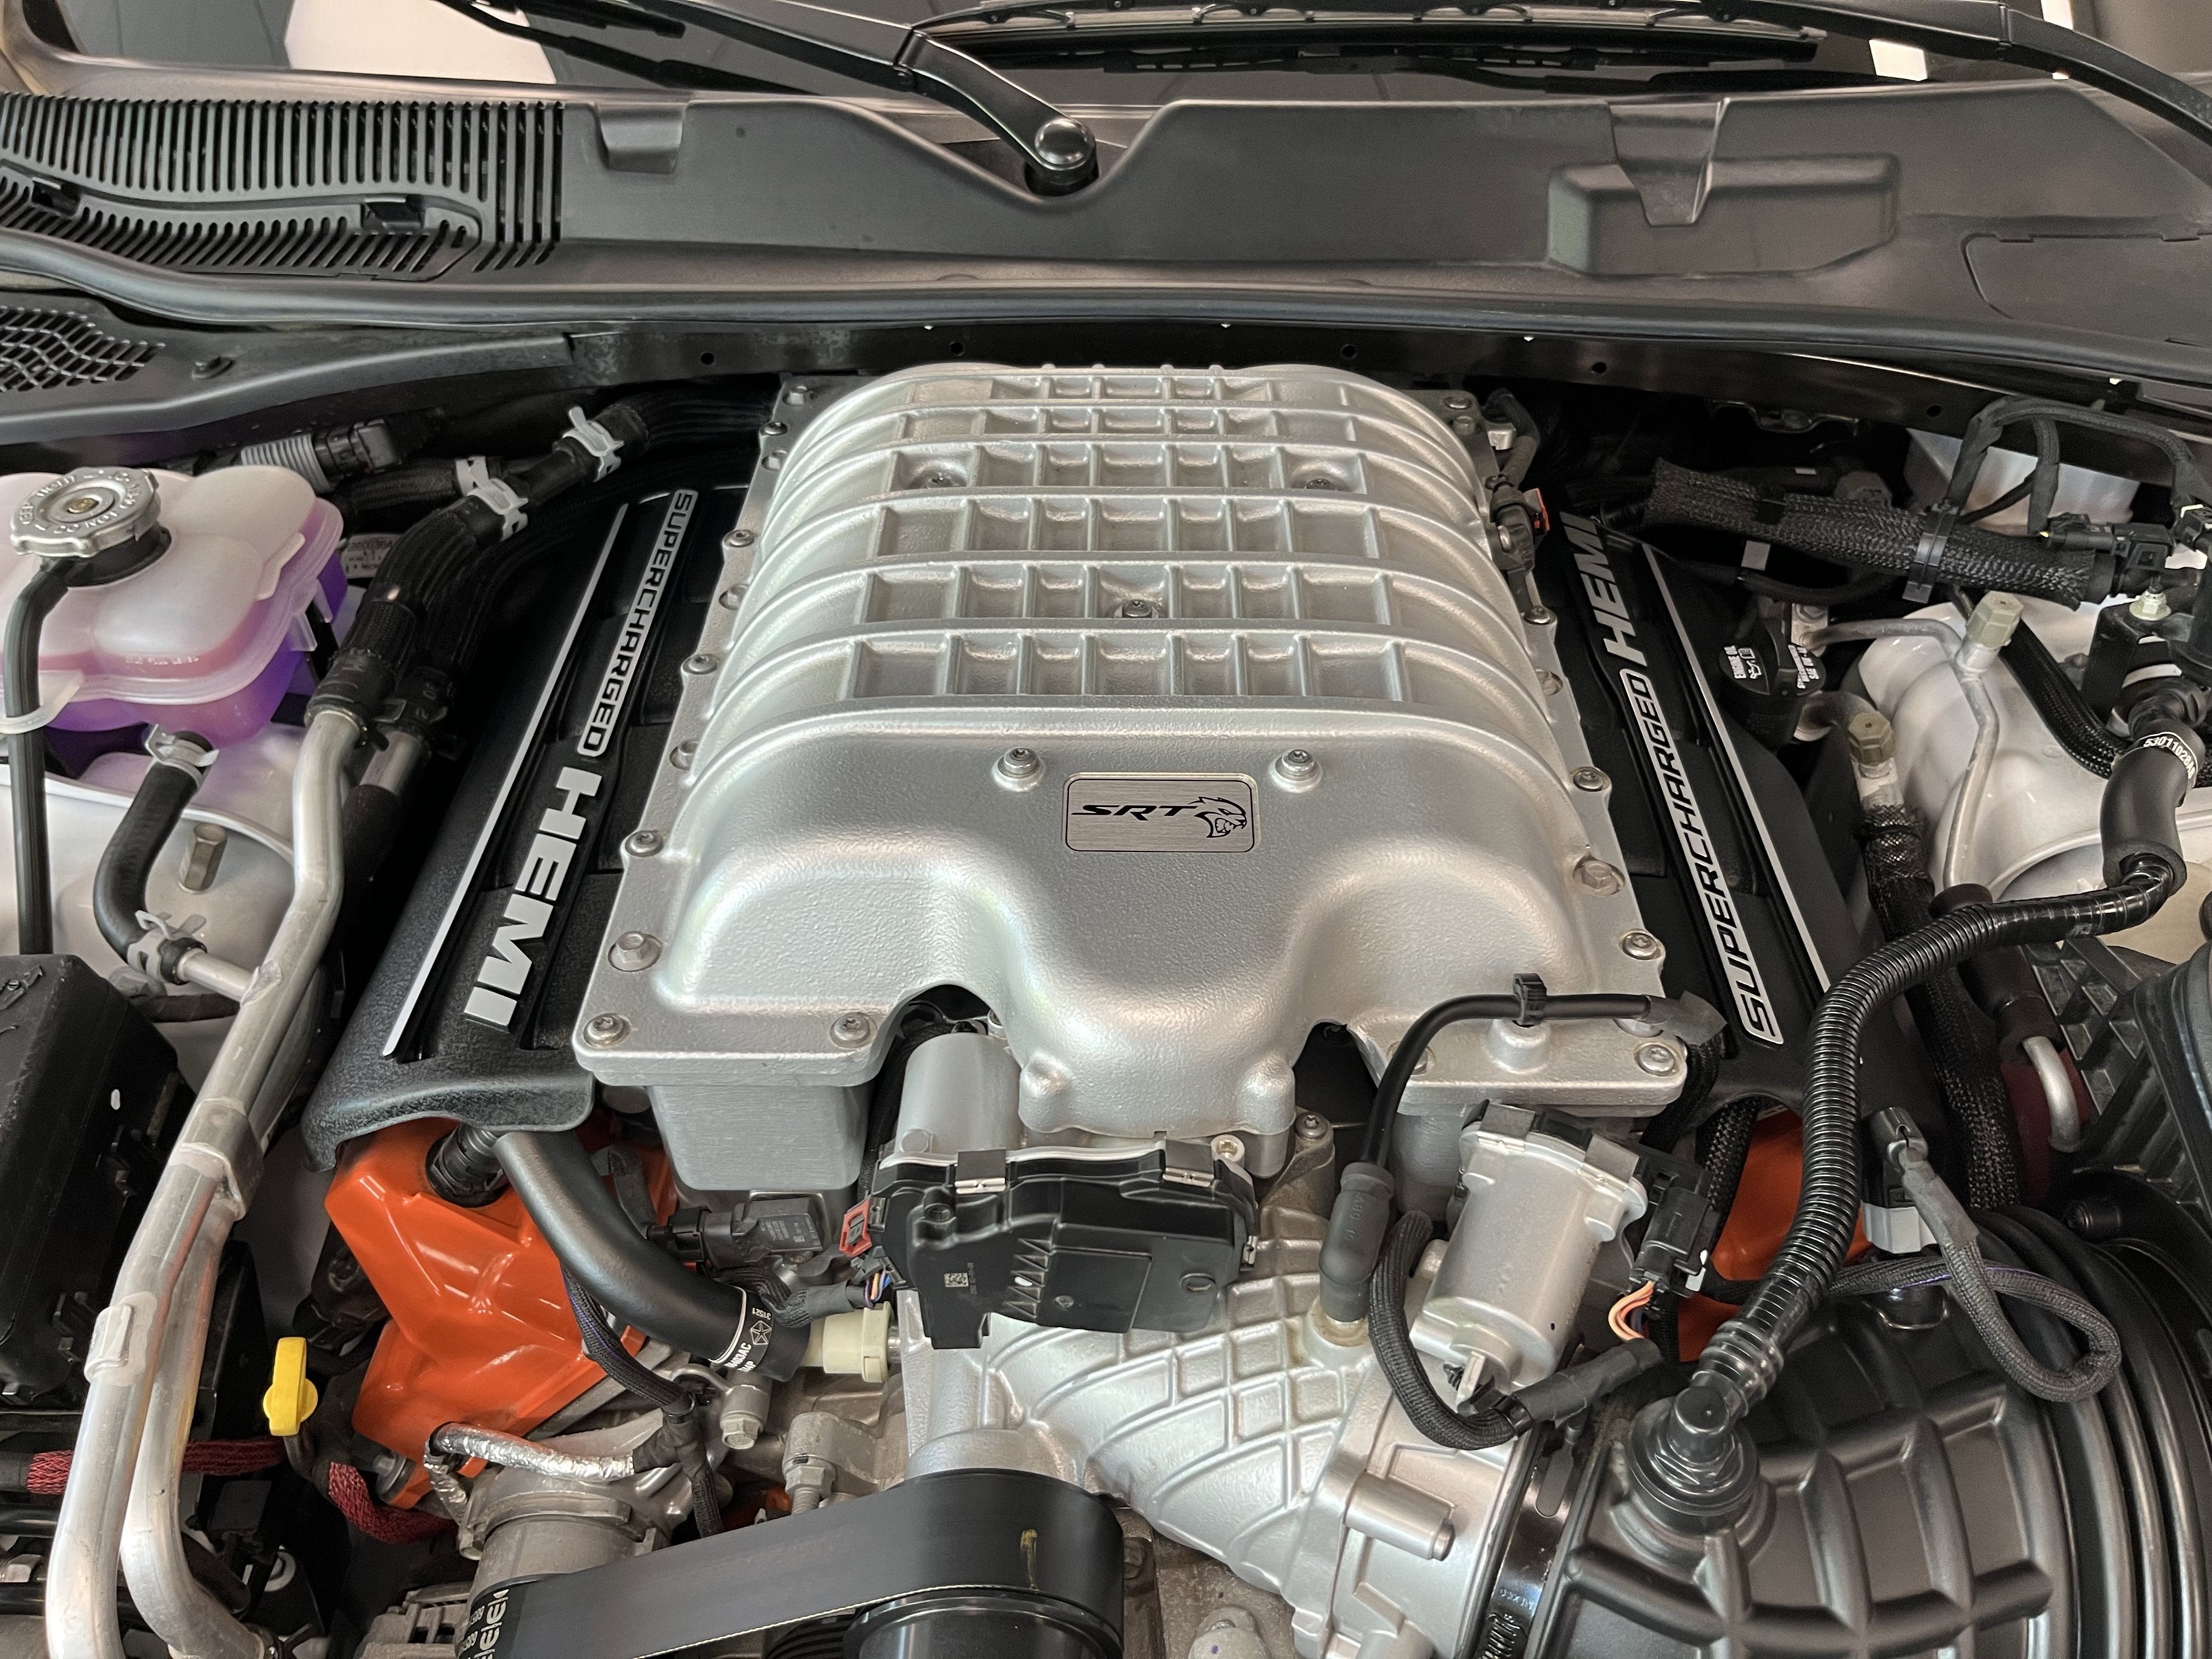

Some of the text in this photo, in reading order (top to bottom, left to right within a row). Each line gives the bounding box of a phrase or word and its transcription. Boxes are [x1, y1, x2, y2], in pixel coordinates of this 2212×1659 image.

[464, 491, 693, 1028] SUPERCHARGED HEMI
[1071, 804, 1198, 821] SRT
[1559, 511, 1780, 1040] SUPERCHARGED HEMI
